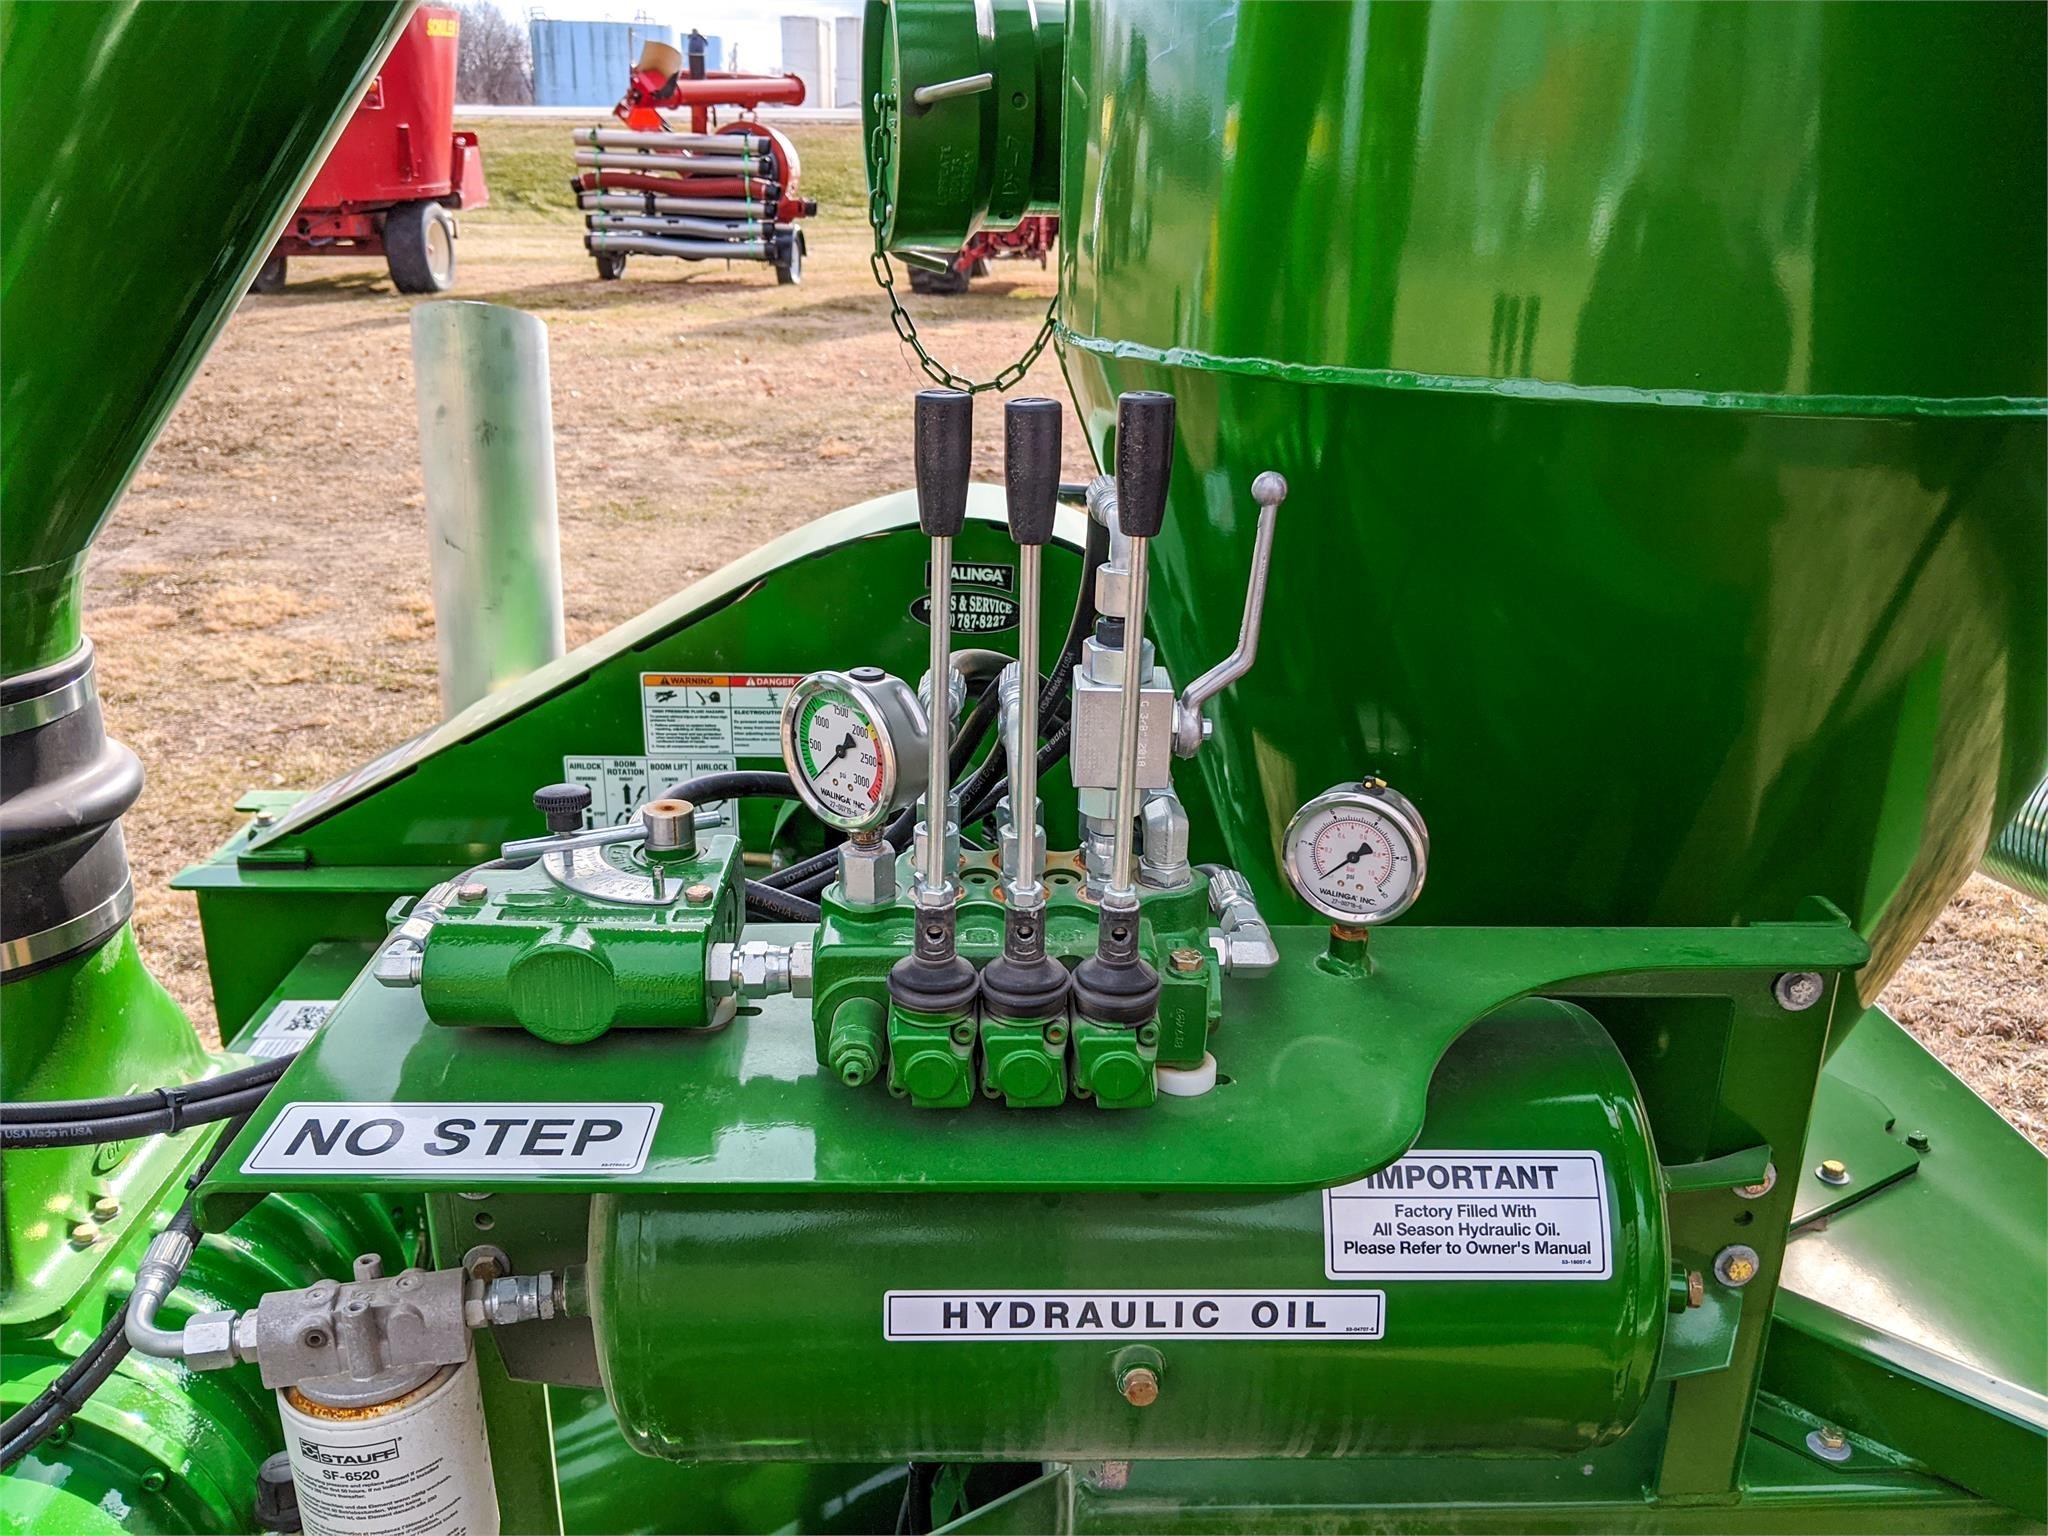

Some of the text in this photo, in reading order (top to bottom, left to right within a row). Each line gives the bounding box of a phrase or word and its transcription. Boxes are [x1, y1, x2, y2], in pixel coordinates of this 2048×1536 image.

[951, 566, 1003, 582] ALINGA
[958, 594, 968, 612] &
[969, 595, 1013, 615] SERVICE
[671, 677, 714, 685] WARNING
[756, 678, 795, 686] DANGER
[833, 704, 849, 718] 1500
[814, 715, 830, 729] 1000
[852, 724, 869, 739] 2000
[809, 738, 822, 751] 500
[569, 762, 602, 770] AIRLOCK
[614, 760, 637, 768] BOOM
[650, 763, 688, 771] BOOM LIFT
[696, 763, 729, 771] AIRLOCK
[860, 752, 877, 768] 2500
[607, 767, 645, 776] ROTATION
[853, 773, 870, 789] 3000
[1360, 896, 1377, 906] INC.
[283, 1118, 623, 1157] NO STEP
[1367, 1165, 1559, 1190] IMPORTANT
[1394, 1204, 1537, 1220] Factory Filled With
[1372, 1222, 1561, 1239] All Season Hydraulic Oil.
[1343, 1241, 1592, 1256] Please Refer to Owner's Manual
[942, 1300, 1327, 1330] HYDRAULIC OIL
[320, 1447, 397, 1464] STAUFF
[322, 1469, 380, 1482] SF-6520
